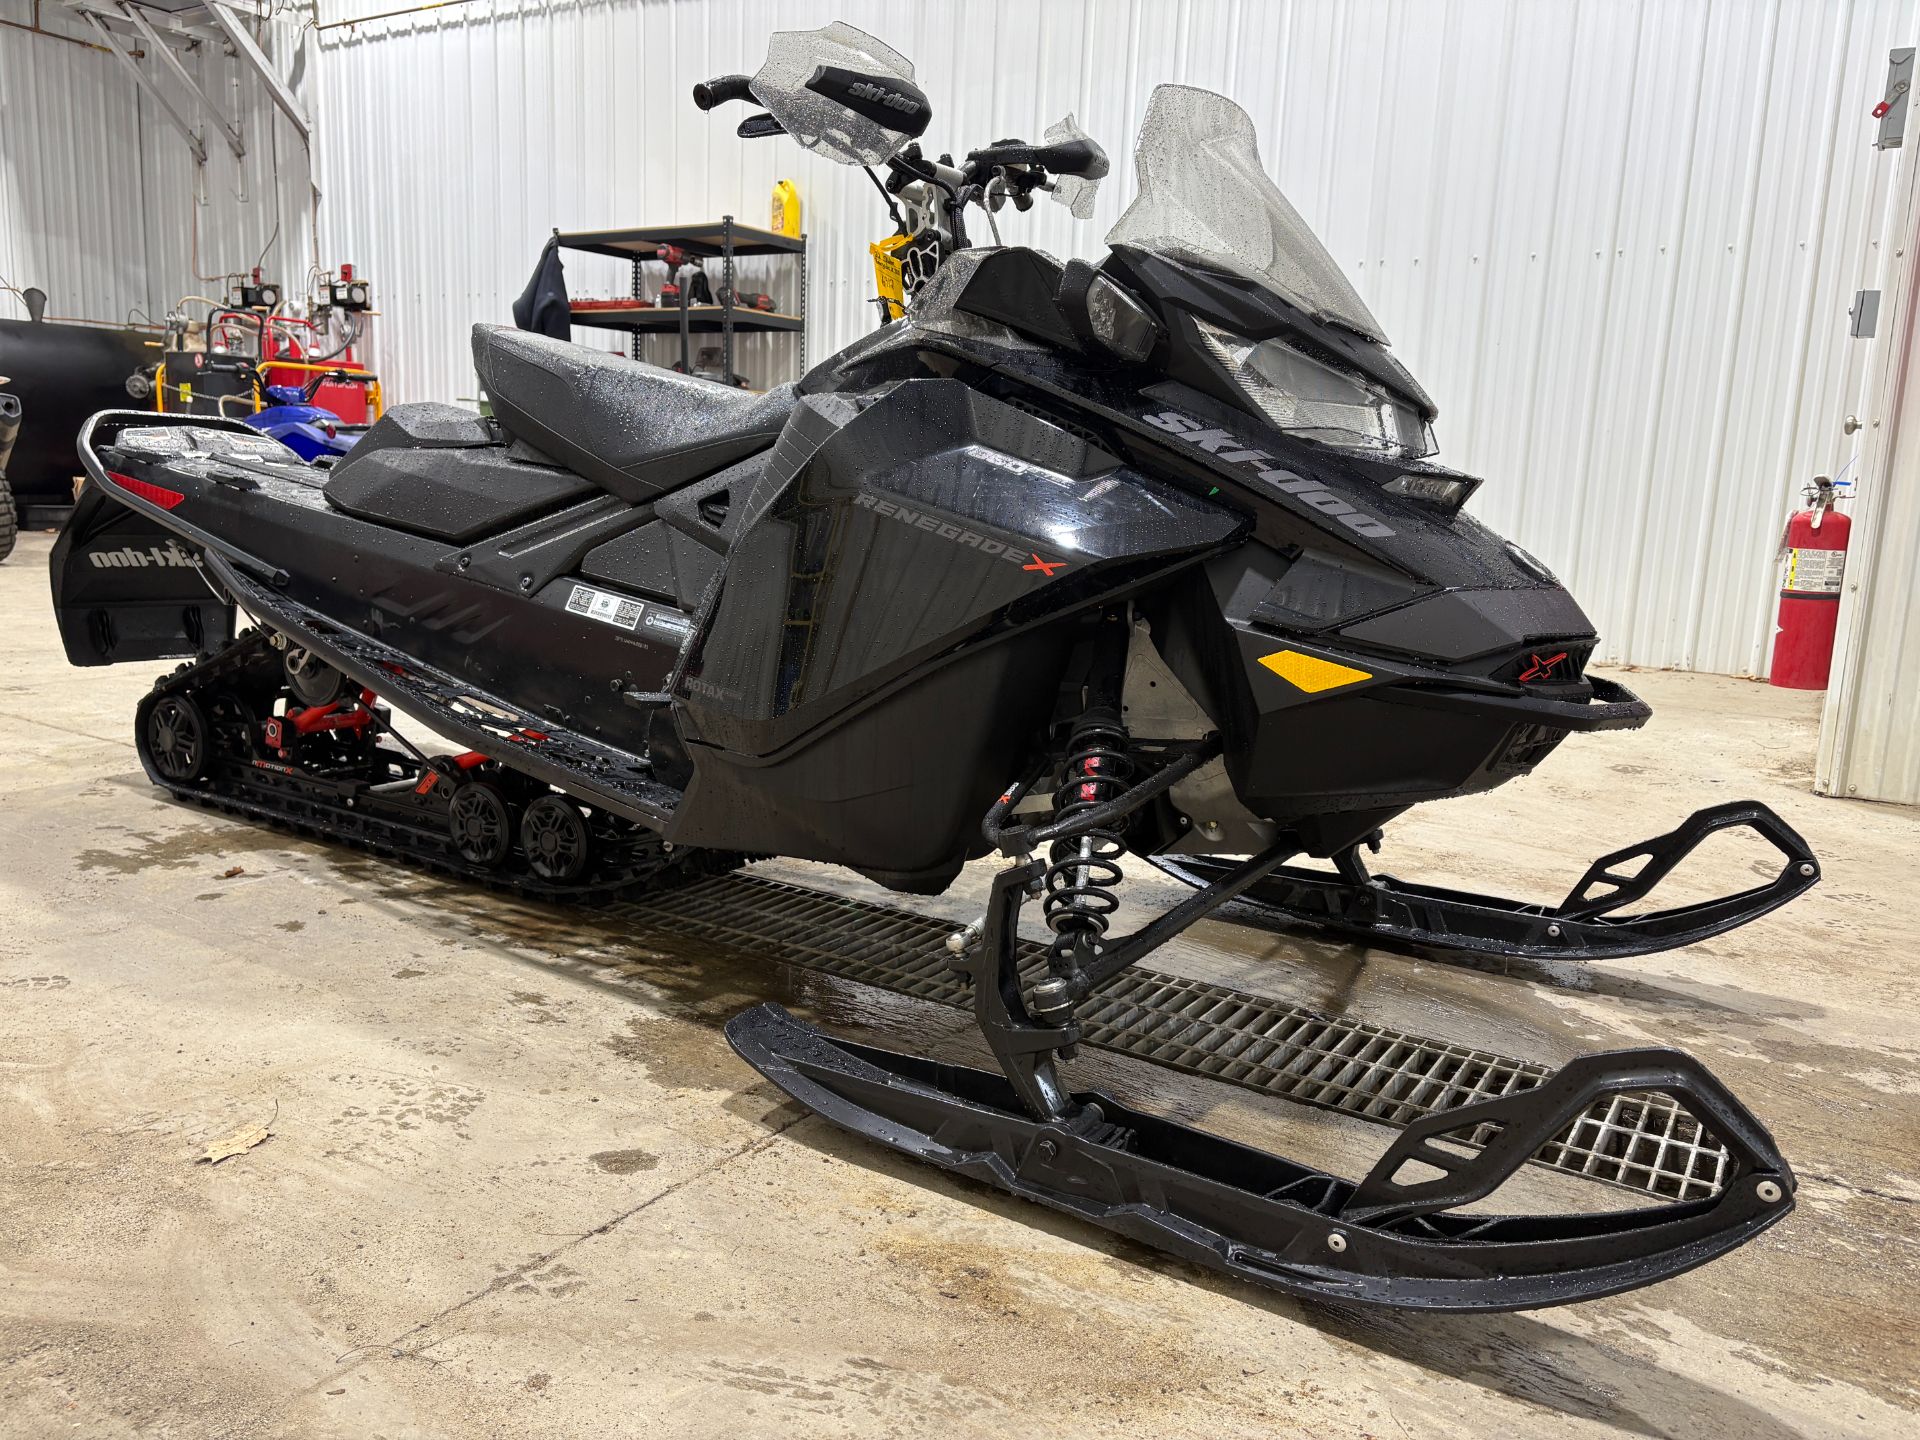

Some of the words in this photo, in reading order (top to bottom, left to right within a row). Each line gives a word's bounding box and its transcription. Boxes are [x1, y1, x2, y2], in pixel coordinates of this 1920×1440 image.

[848, 82, 921, 115] ski-doo
[1142, 411, 1397, 538] ski-doo
[853, 492, 1030, 564] RENEGADE
